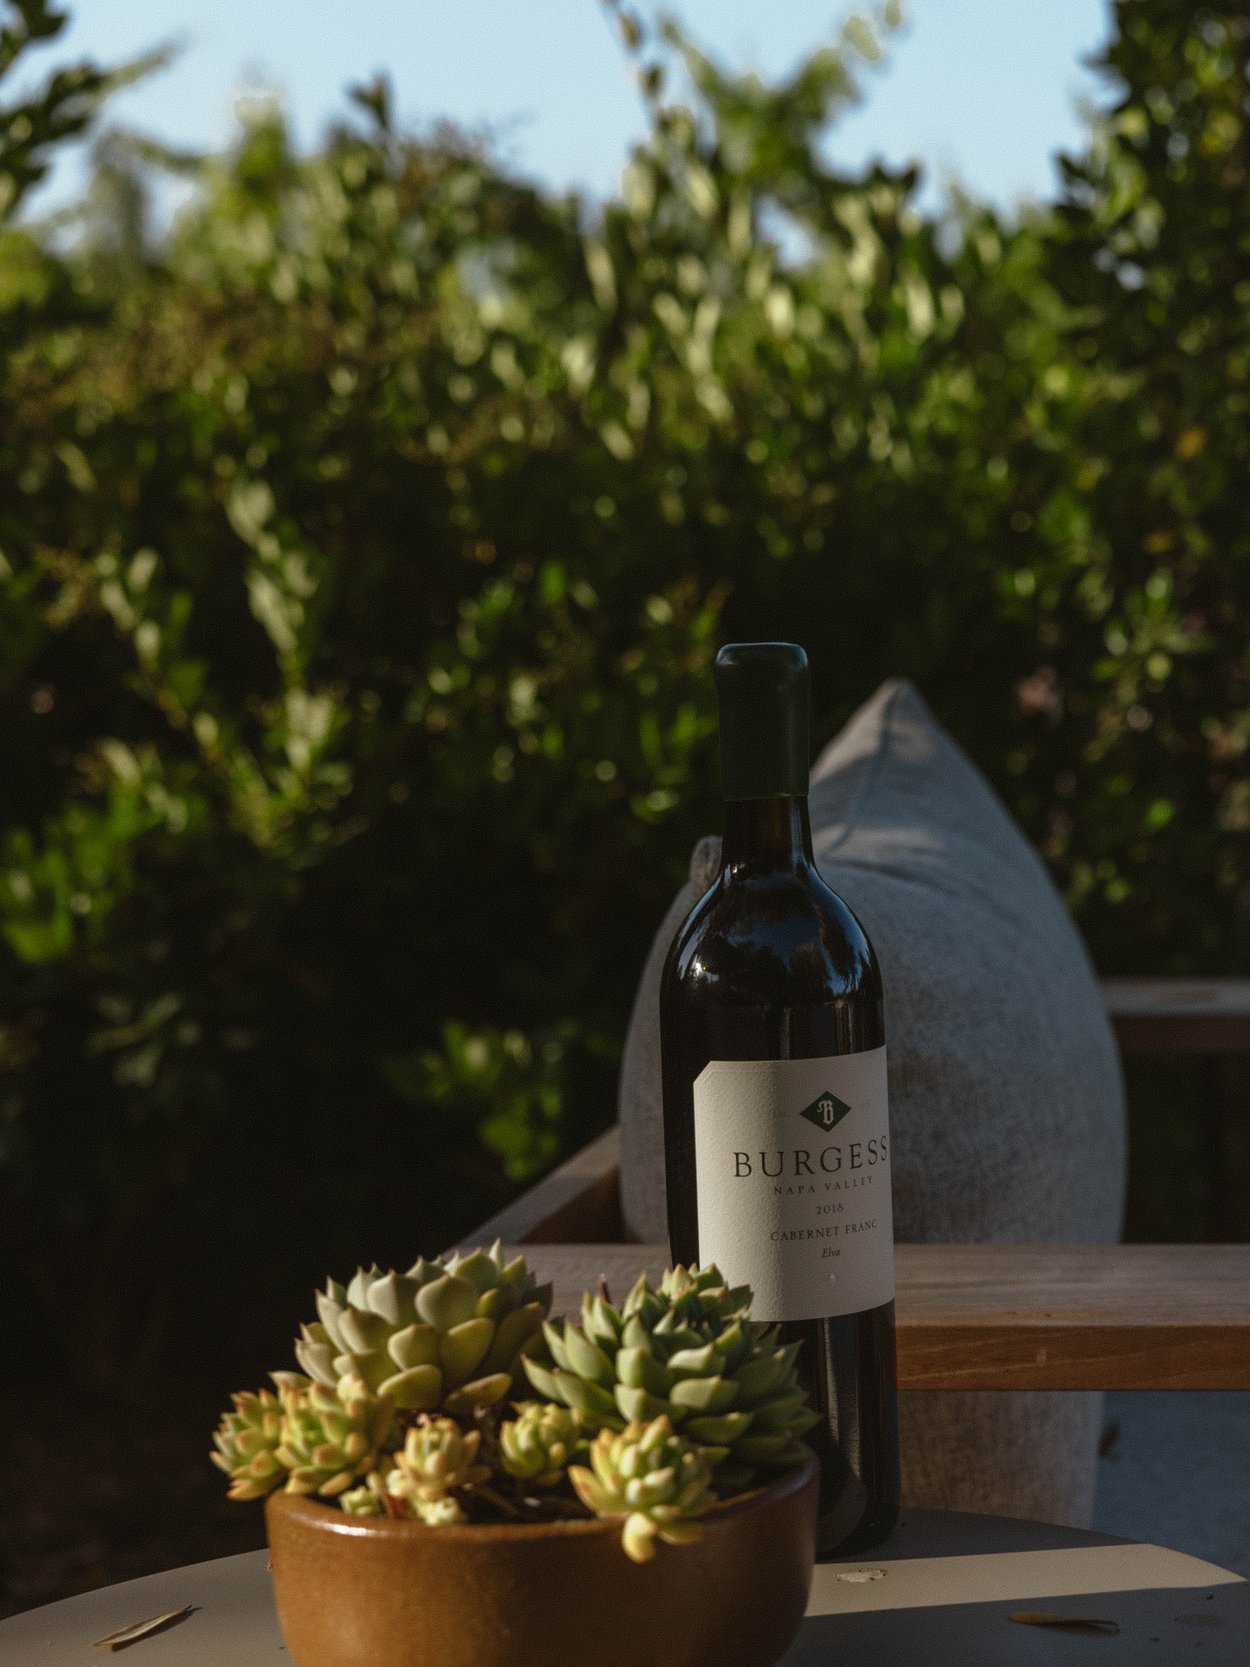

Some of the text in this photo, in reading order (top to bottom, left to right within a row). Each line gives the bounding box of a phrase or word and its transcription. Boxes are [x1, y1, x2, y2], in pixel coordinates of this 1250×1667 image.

[733, 1136, 888, 1178] BURGESS
[774, 1175, 873, 1196] NAPA VALLEY
[816, 1203, 844, 1215] 2018
[770, 1219, 878, 1241] CABERNET FRANC
[821, 1246, 840, 1258] Elva
